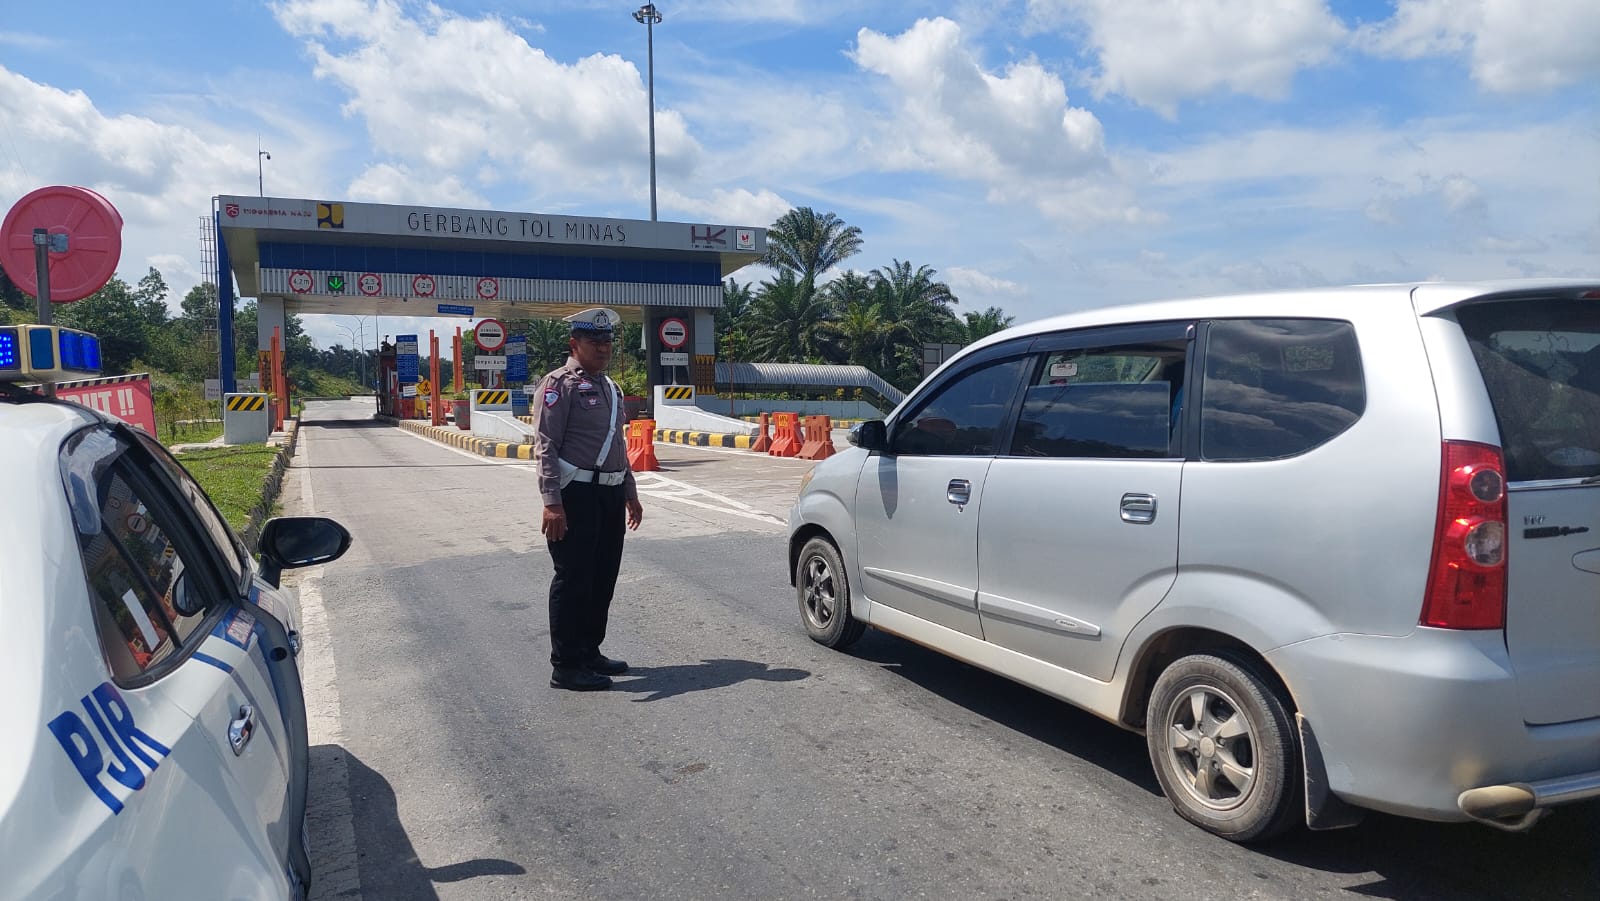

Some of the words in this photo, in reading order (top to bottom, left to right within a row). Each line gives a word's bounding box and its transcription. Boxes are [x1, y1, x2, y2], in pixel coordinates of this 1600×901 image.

[407, 211, 508, 236] GERBANG
[519, 218, 556, 239] TOL
[565, 222, 627, 243] MINAS
[691, 225, 727, 245] HK
[47, 681, 172, 816] PJR
